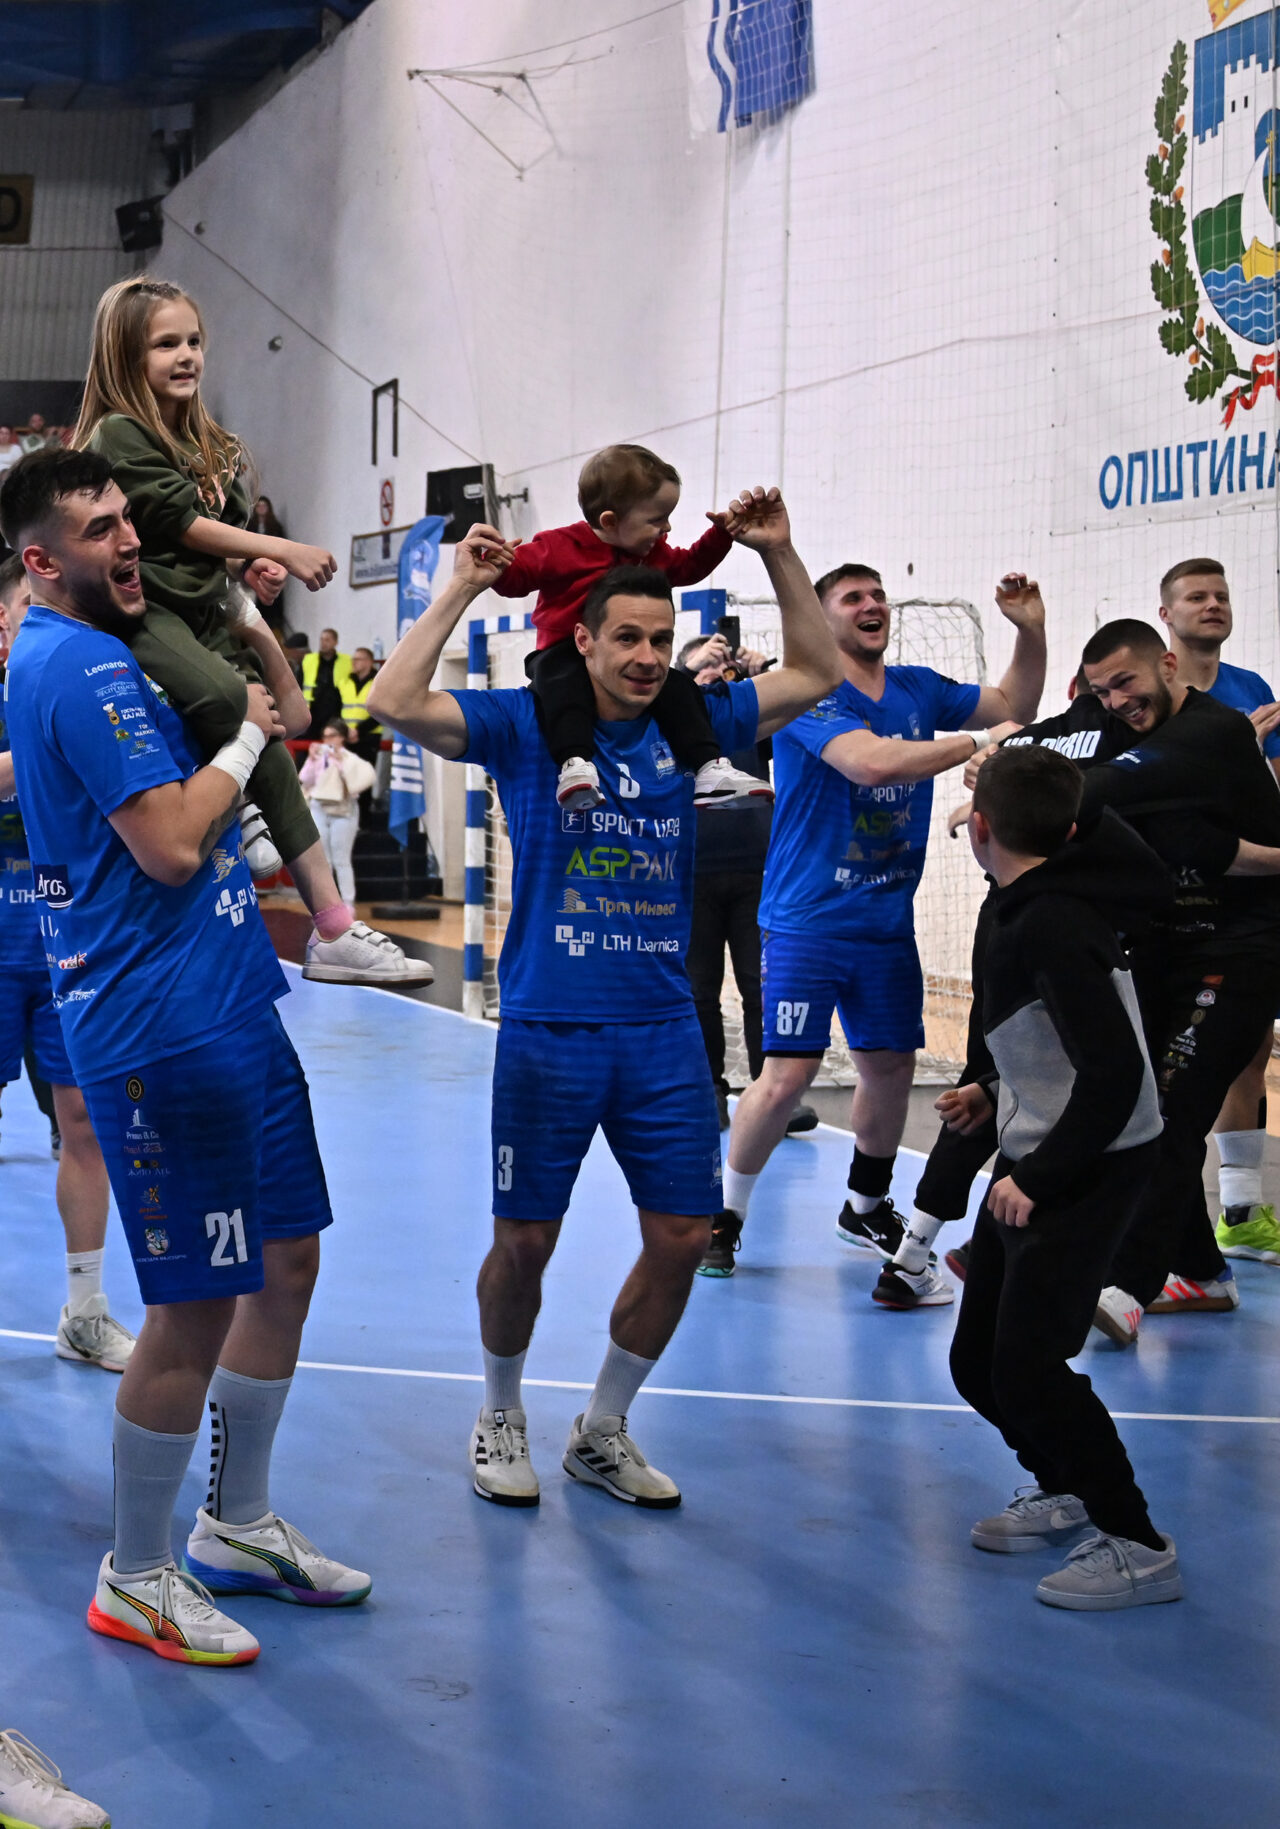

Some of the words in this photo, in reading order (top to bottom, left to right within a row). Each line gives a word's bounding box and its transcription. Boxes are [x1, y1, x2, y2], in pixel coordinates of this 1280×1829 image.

[603, 934, 631, 951] LTH
[637, 935, 679, 953] Larnica
[777, 1000, 809, 1036] 87
[498, 1144, 513, 1191] 3
[205, 1208, 249, 1267] 21
